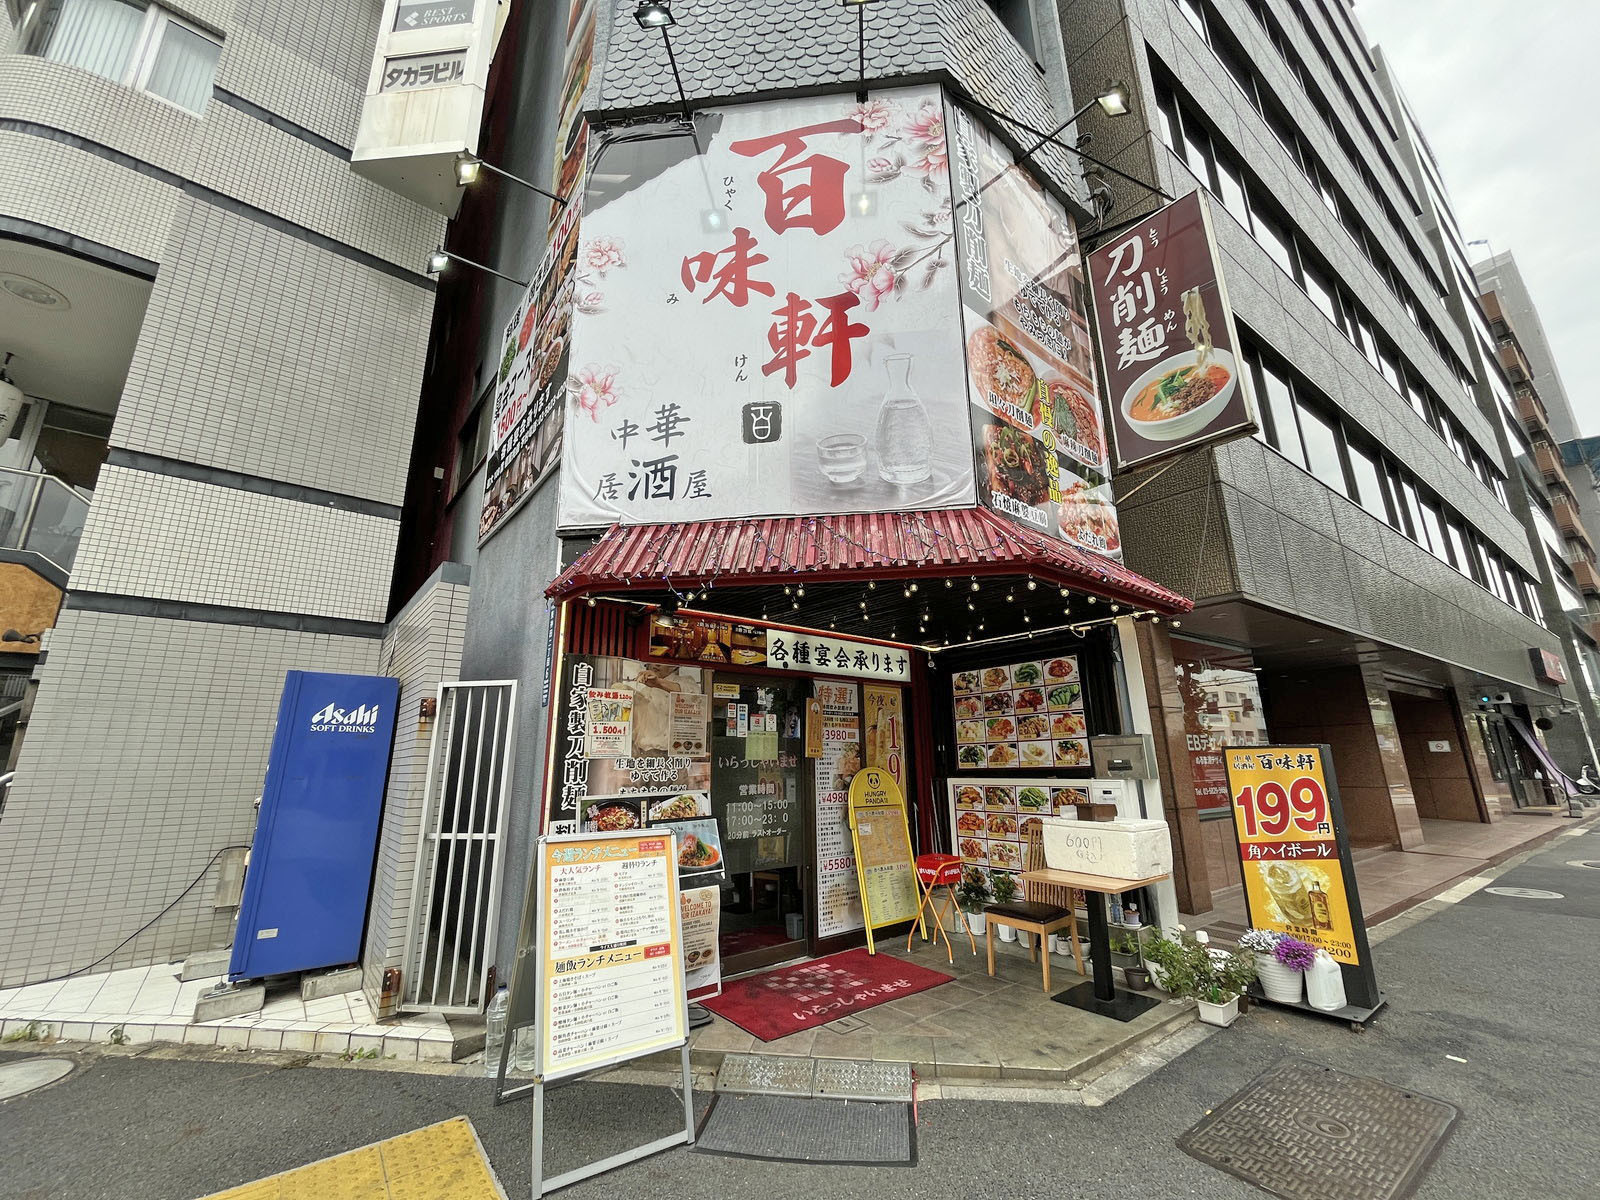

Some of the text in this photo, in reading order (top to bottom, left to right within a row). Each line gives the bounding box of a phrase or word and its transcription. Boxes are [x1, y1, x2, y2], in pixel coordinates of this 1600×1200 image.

[421, 13, 467, 26] SPORTS
[424, 6, 456, 18] BEST
[384, 60, 464, 88] タカラビル
[1149, 227, 1159, 249] とう
[1155, 266, 1169, 296] しょう
[667, 293, 679, 305] み
[1104, 235, 1170, 371] 刀削麺
[1163, 308, 1178, 333] めん
[734, 354, 748, 382] けん
[610, 403, 691, 450] 中華
[1037, 378, 1063, 504] 自慢の逸品
[593, 454, 713, 502] 居酒屋
[769, 637, 908, 676] 各種宴会承ります
[312, 702, 379, 725] Asahi
[310, 724, 375, 733] SOFT DRINKS
[561, 662, 594, 811] 自家製刀削麺
[615, 757, 692, 770] 生地を細長く削り
[718, 752, 798, 769] いらっしゃいませ
[1256, 753, 1316, 770] 百味軒
[630, 769, 679, 782] ゆでて作る
[739, 783, 775, 796] 営業時間
[751, 827, 787, 838] ラストオーダー
[1248, 842, 1332, 860] 角ハイボール
[1285, 924, 1318, 936] 営業時間
[555, 951, 642, 974] 麺飯ランチメニュー
[793, 978, 912, 1020] いらっしゃいませ
